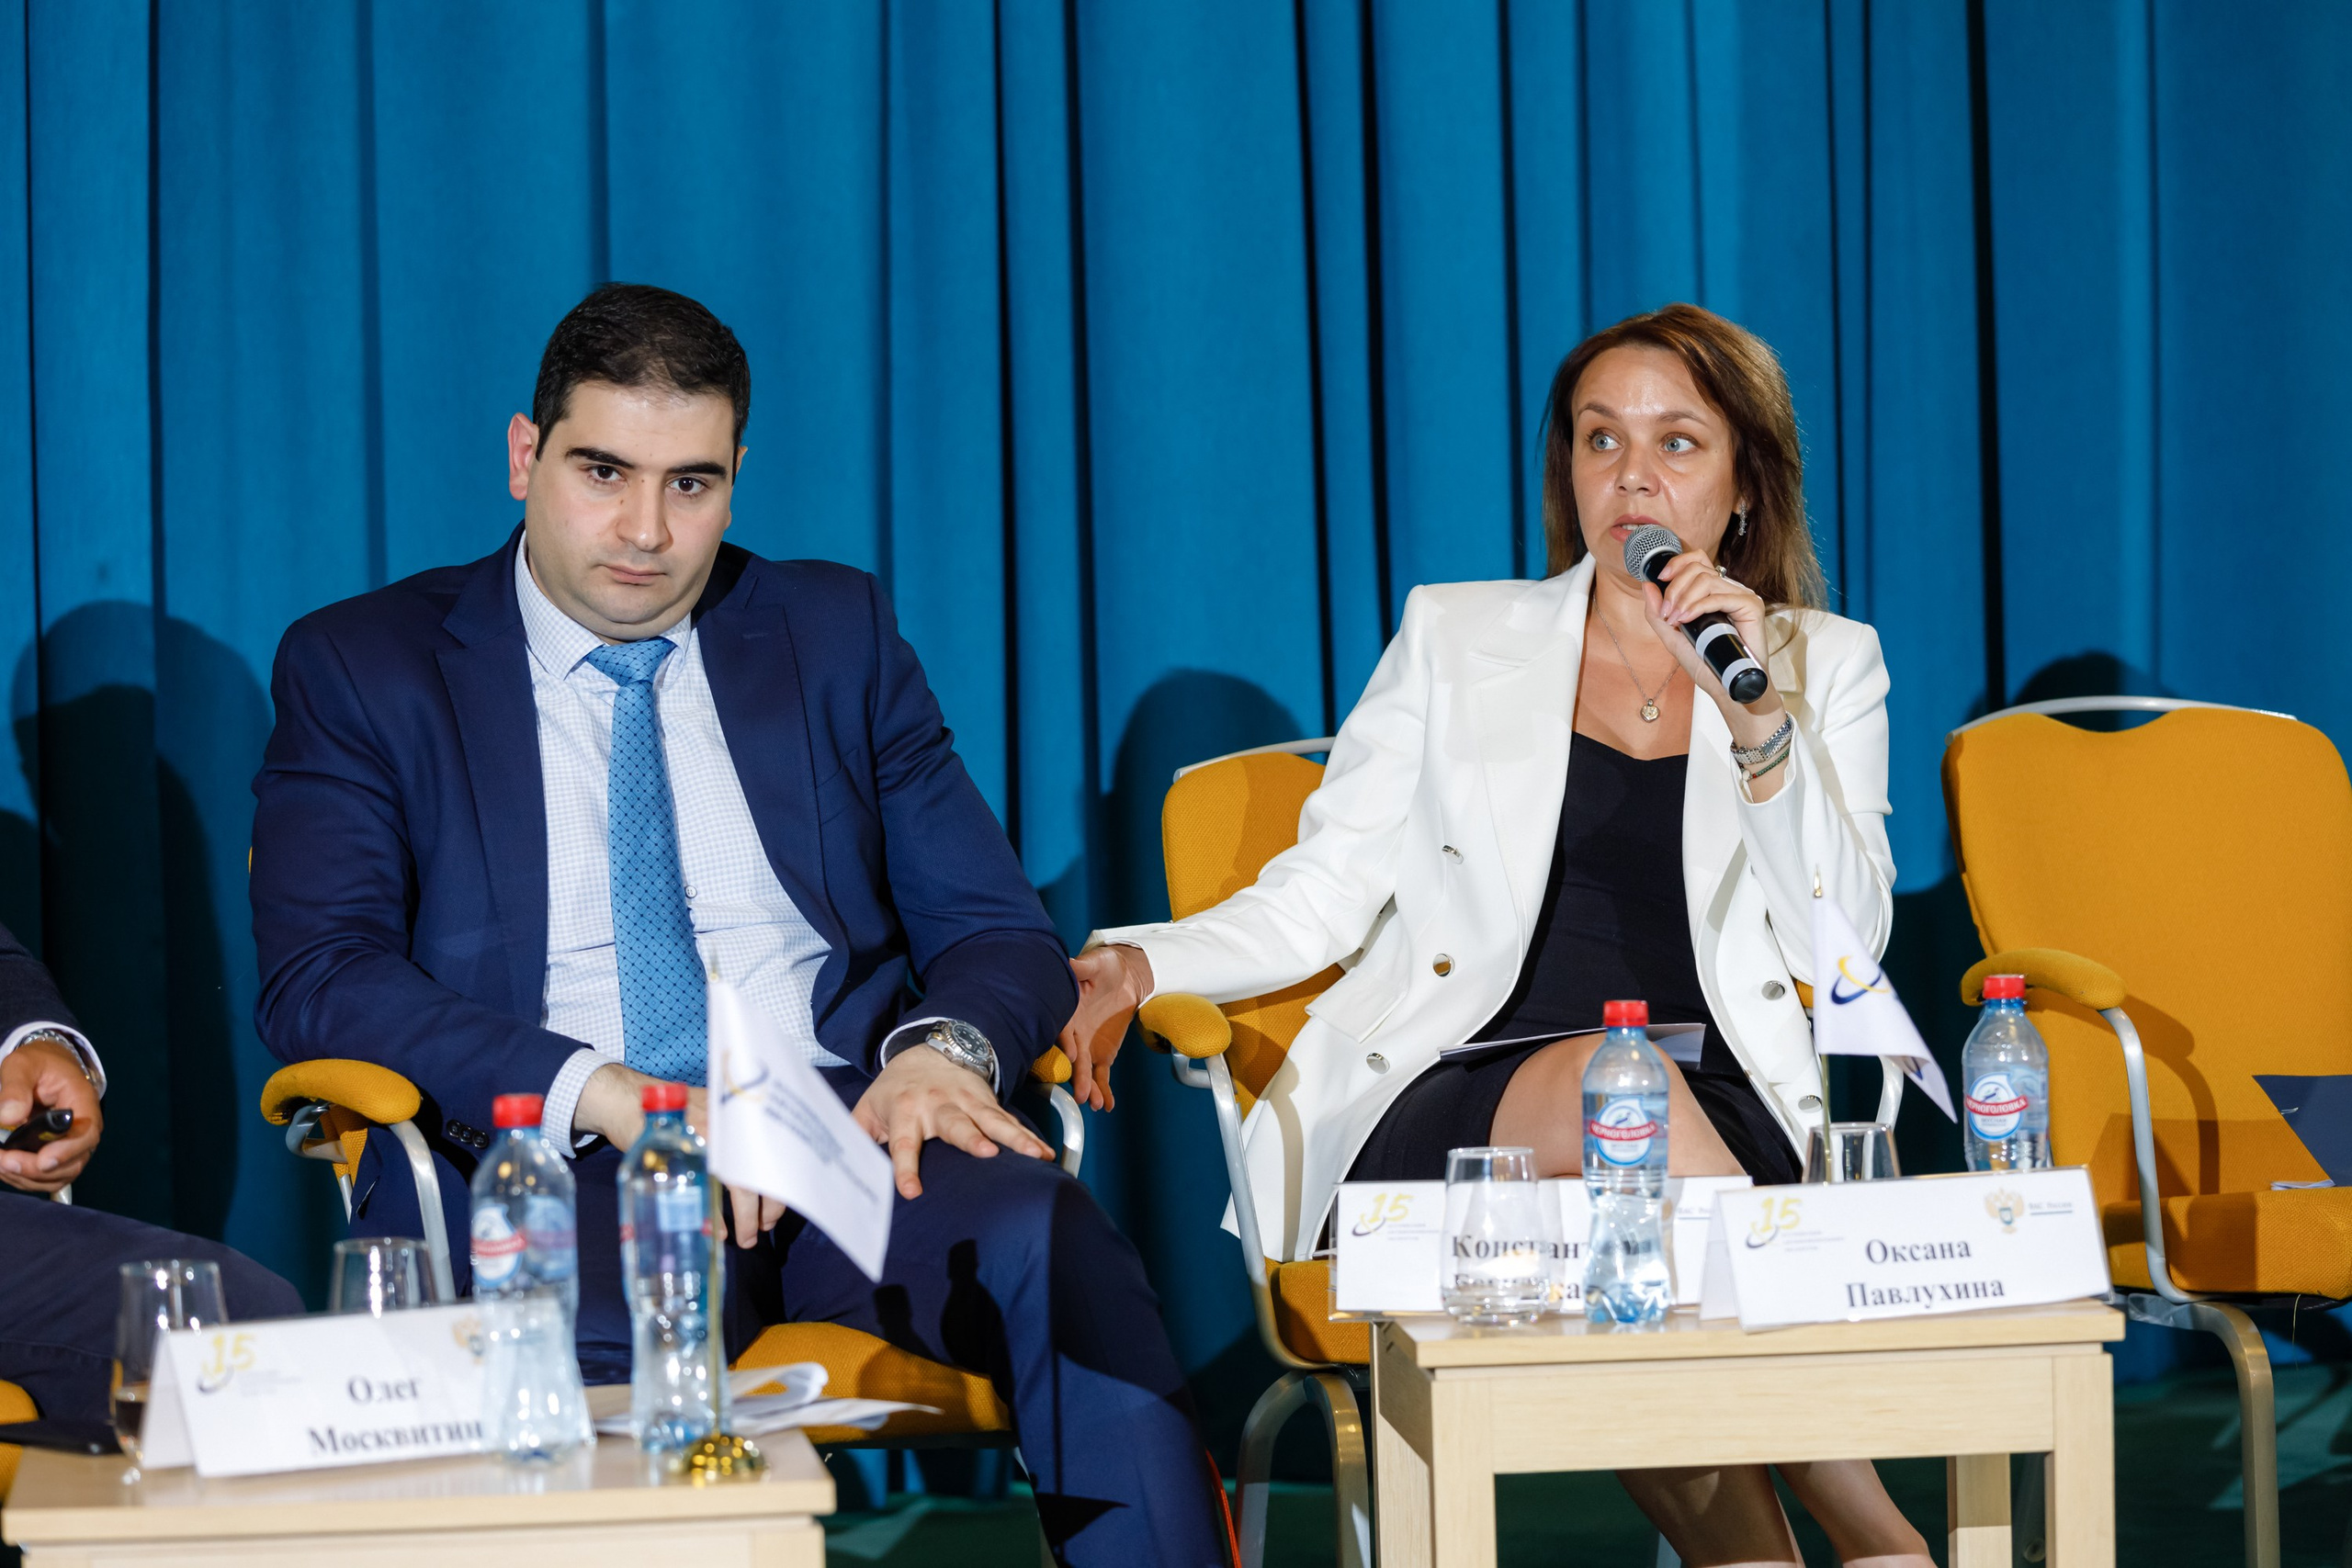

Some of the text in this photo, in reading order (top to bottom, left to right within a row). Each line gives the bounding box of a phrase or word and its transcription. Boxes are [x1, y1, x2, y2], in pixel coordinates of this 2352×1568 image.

[1365, 1192, 1414, 1224] 15
[1758, 1196, 1803, 1232] 15
[1864, 1239, 1972, 1264] Оксана
[1846, 1280, 2006, 1309] Павлухина
[209, 1332, 255, 1374] 15
[346, 1377, 422, 1404] Олег
[308, 1418, 484, 1454] Москвитин
